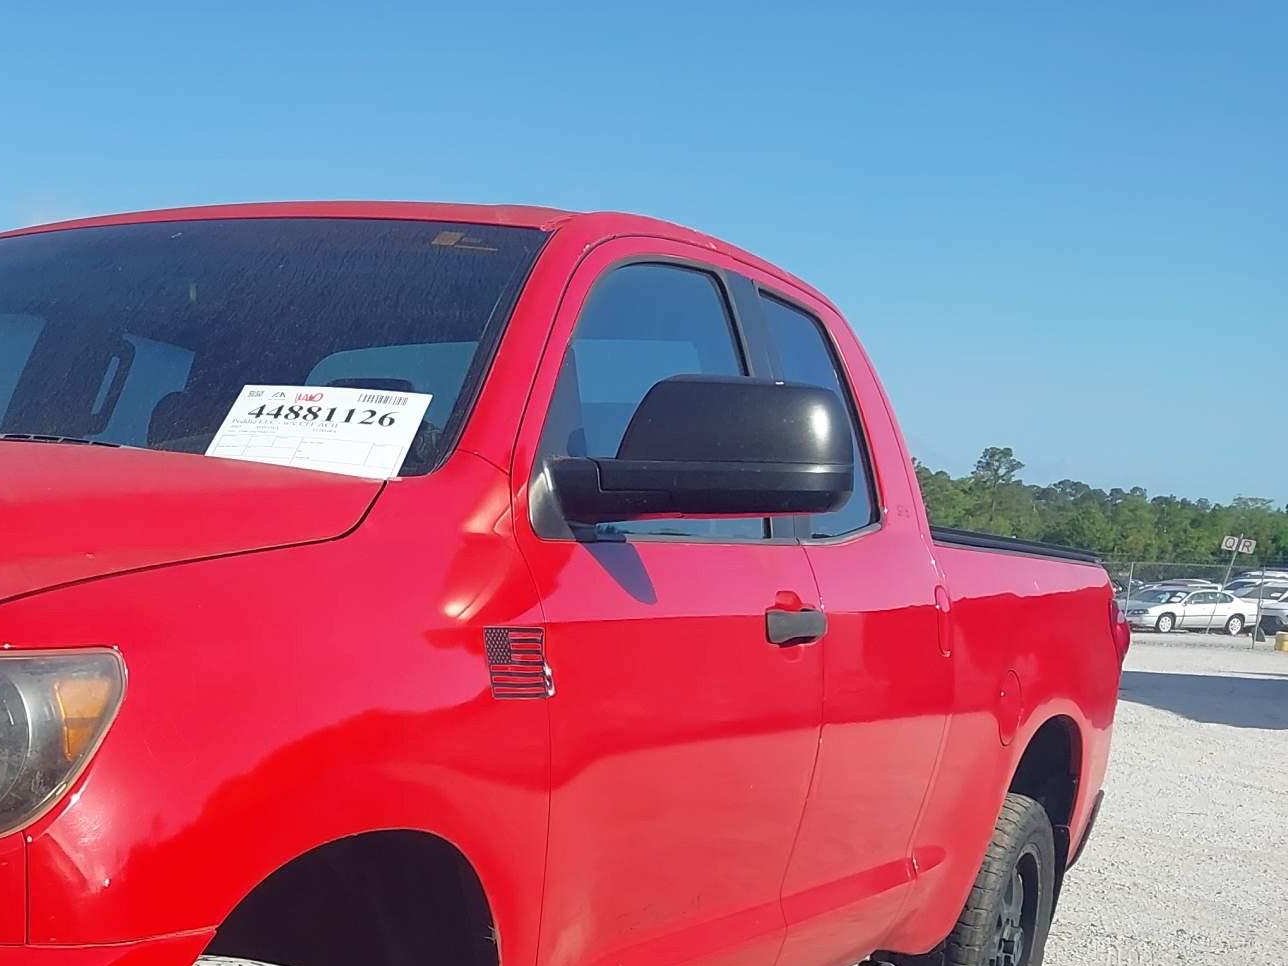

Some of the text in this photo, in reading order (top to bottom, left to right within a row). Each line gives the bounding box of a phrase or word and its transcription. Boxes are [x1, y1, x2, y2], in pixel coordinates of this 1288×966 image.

[248, 404, 399, 427] 44881126
[1225, 536, 1236, 549] Q
[1242, 540, 1253, 552] R
